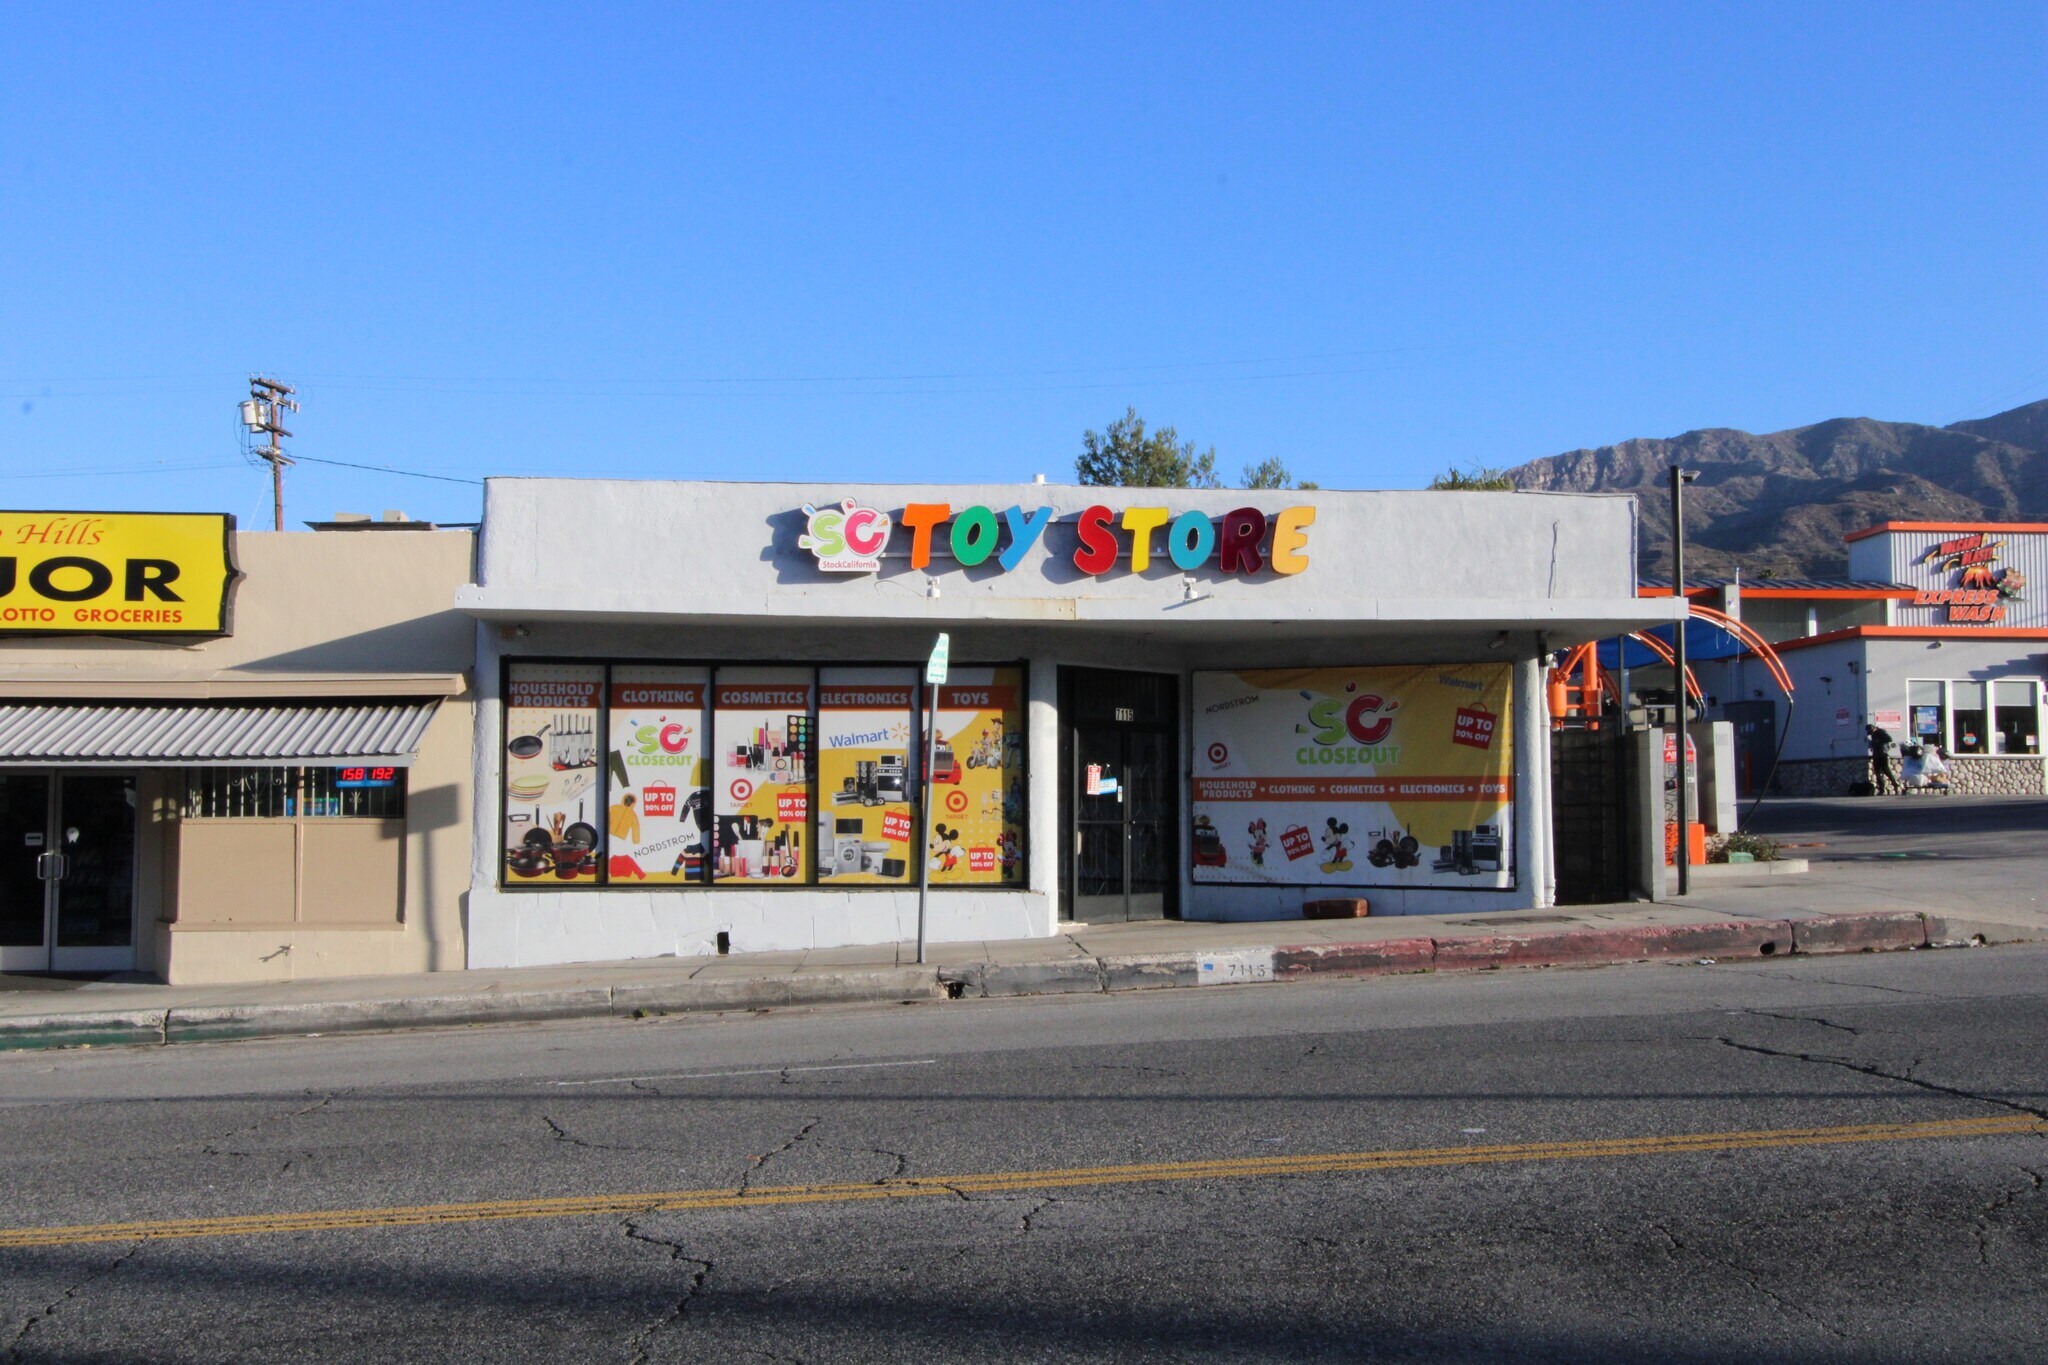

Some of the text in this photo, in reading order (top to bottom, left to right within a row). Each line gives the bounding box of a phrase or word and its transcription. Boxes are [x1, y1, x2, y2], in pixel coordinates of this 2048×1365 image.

[17, 517, 104, 545] Hills
[902, 503, 1316, 576] TOY STORE
[822, 560, 877, 569] StockCalifornia
[1913, 589, 1999, 605] EXPRESS
[74, 608, 183, 623] GROCERIES
[1949, 605, 2007, 622] WASH
[509, 683, 595, 696] HOUSEHOLD
[1439, 675, 1484, 691] Walmart
[514, 695, 589, 707] PRODUCTS
[622, 690, 694, 703] CLOTHING
[722, 691, 804, 705] COSMETICS
[821, 693, 908, 705] ELECTRONICS
[952, 692, 989, 705] TOYS
[1205, 695, 1260, 714] NORDSTROM
[1116, 708, 1133, 721] 7115
[1457, 715, 1493, 732] UP TO
[829, 729, 889, 748] Walmart
[1455, 729, 1490, 743] 90% OFF
[627, 755, 692, 767] CLOSEOUT
[1297, 747, 1399, 764] CLOSEOUT
[343, 768, 364, 780] 158
[372, 767, 394, 780] 192
[1200, 781, 1257, 790] HOUSEHOLD
[1269, 784, 1506, 794] CLOTHING COSMETICS ELECTRONICS TOYS
[645, 793, 674, 802] UP TO
[1203, 789, 1254, 799] PRODUCTS
[645, 804, 674, 812] 90% OFF
[778, 799, 808, 808] UP TO
[885, 816, 911, 829] UP TO
[883, 827, 909, 838] 90% OFF
[633, 832, 695, 858] NORDSTROM
[1283, 832, 1309, 847] UP TO
[970, 852, 994, 860] UP TO
[1229, 964, 1265, 977] 7115
